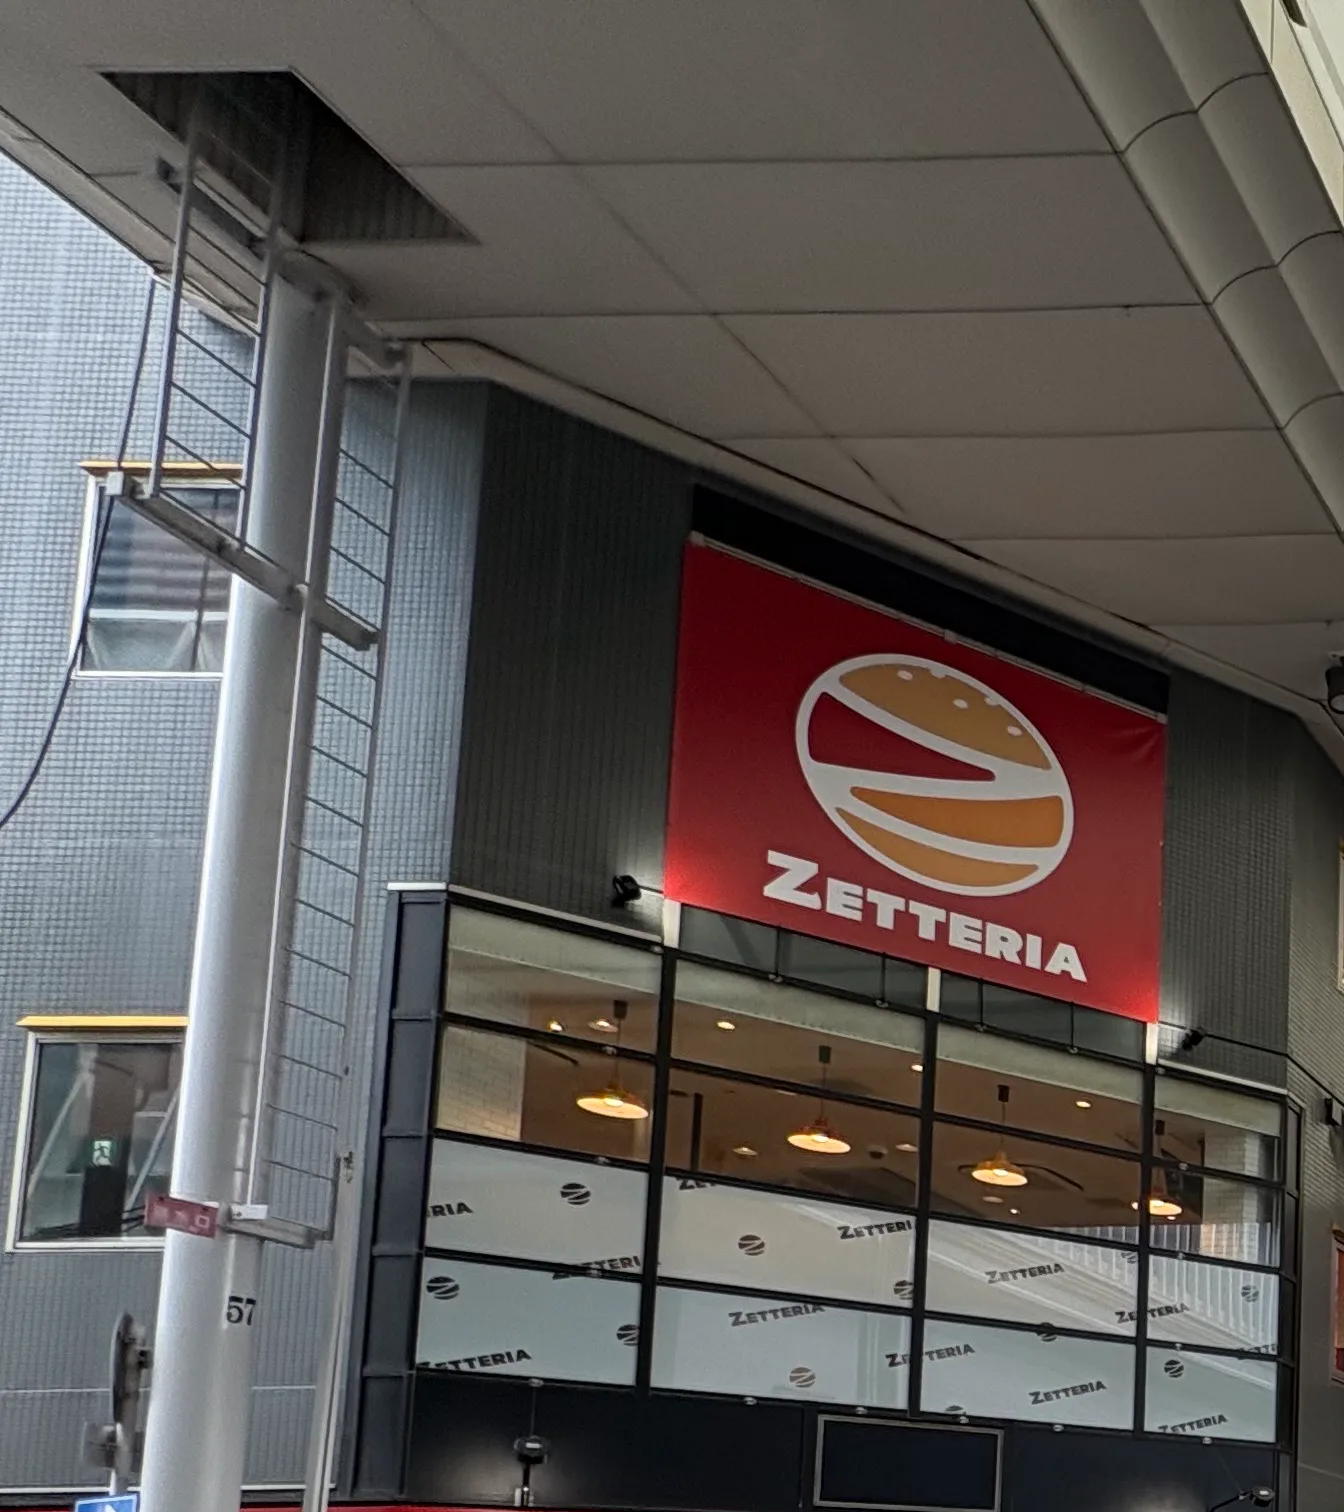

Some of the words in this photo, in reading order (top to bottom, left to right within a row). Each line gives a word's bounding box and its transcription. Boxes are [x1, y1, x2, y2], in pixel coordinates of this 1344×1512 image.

[763, 850, 1087, 983] ZETTERIA
[838, 1219, 912, 1241] ZETTERI
[985, 1263, 1064, 1284] ZETTERIA
[227, 1296, 257, 1326] 57
[728, 1302, 826, 1327] ZETTERIA
[1029, 1379, 1107, 1405] ZETTERIA
